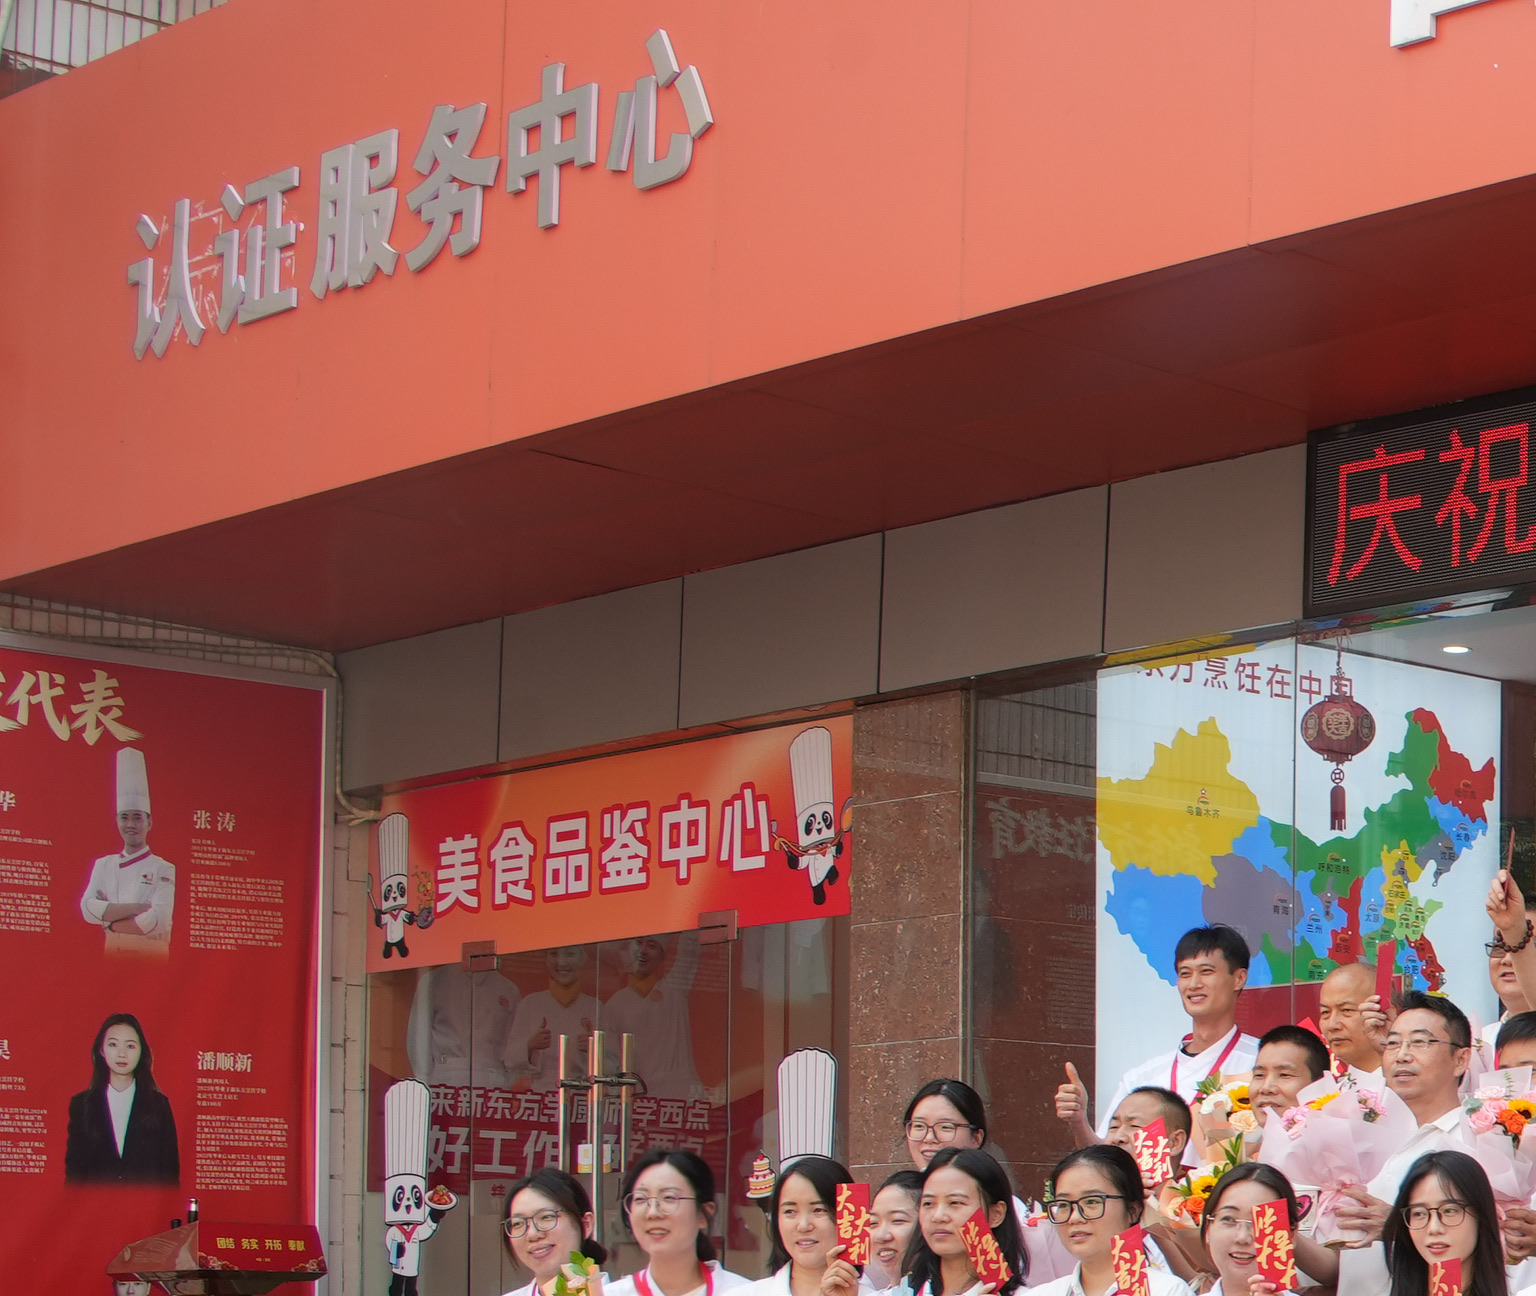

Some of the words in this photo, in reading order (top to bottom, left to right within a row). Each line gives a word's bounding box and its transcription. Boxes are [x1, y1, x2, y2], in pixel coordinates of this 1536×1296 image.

[127, 28, 714, 360] 认证服务中心
[0, 670, 145, 746] 代表
[1186, 805, 1220, 819] 乌鲁木齐
[436, 788, 770, 915] 美食品鉴中心
[197, 1050, 253, 1073] 潘顺新
[217, 1237, 235, 1249] 团结
[241, 1238, 259, 1250] 务实
[265, 1239, 282, 1250] 开拓
[288, 1240, 306, 1251] 奉献
